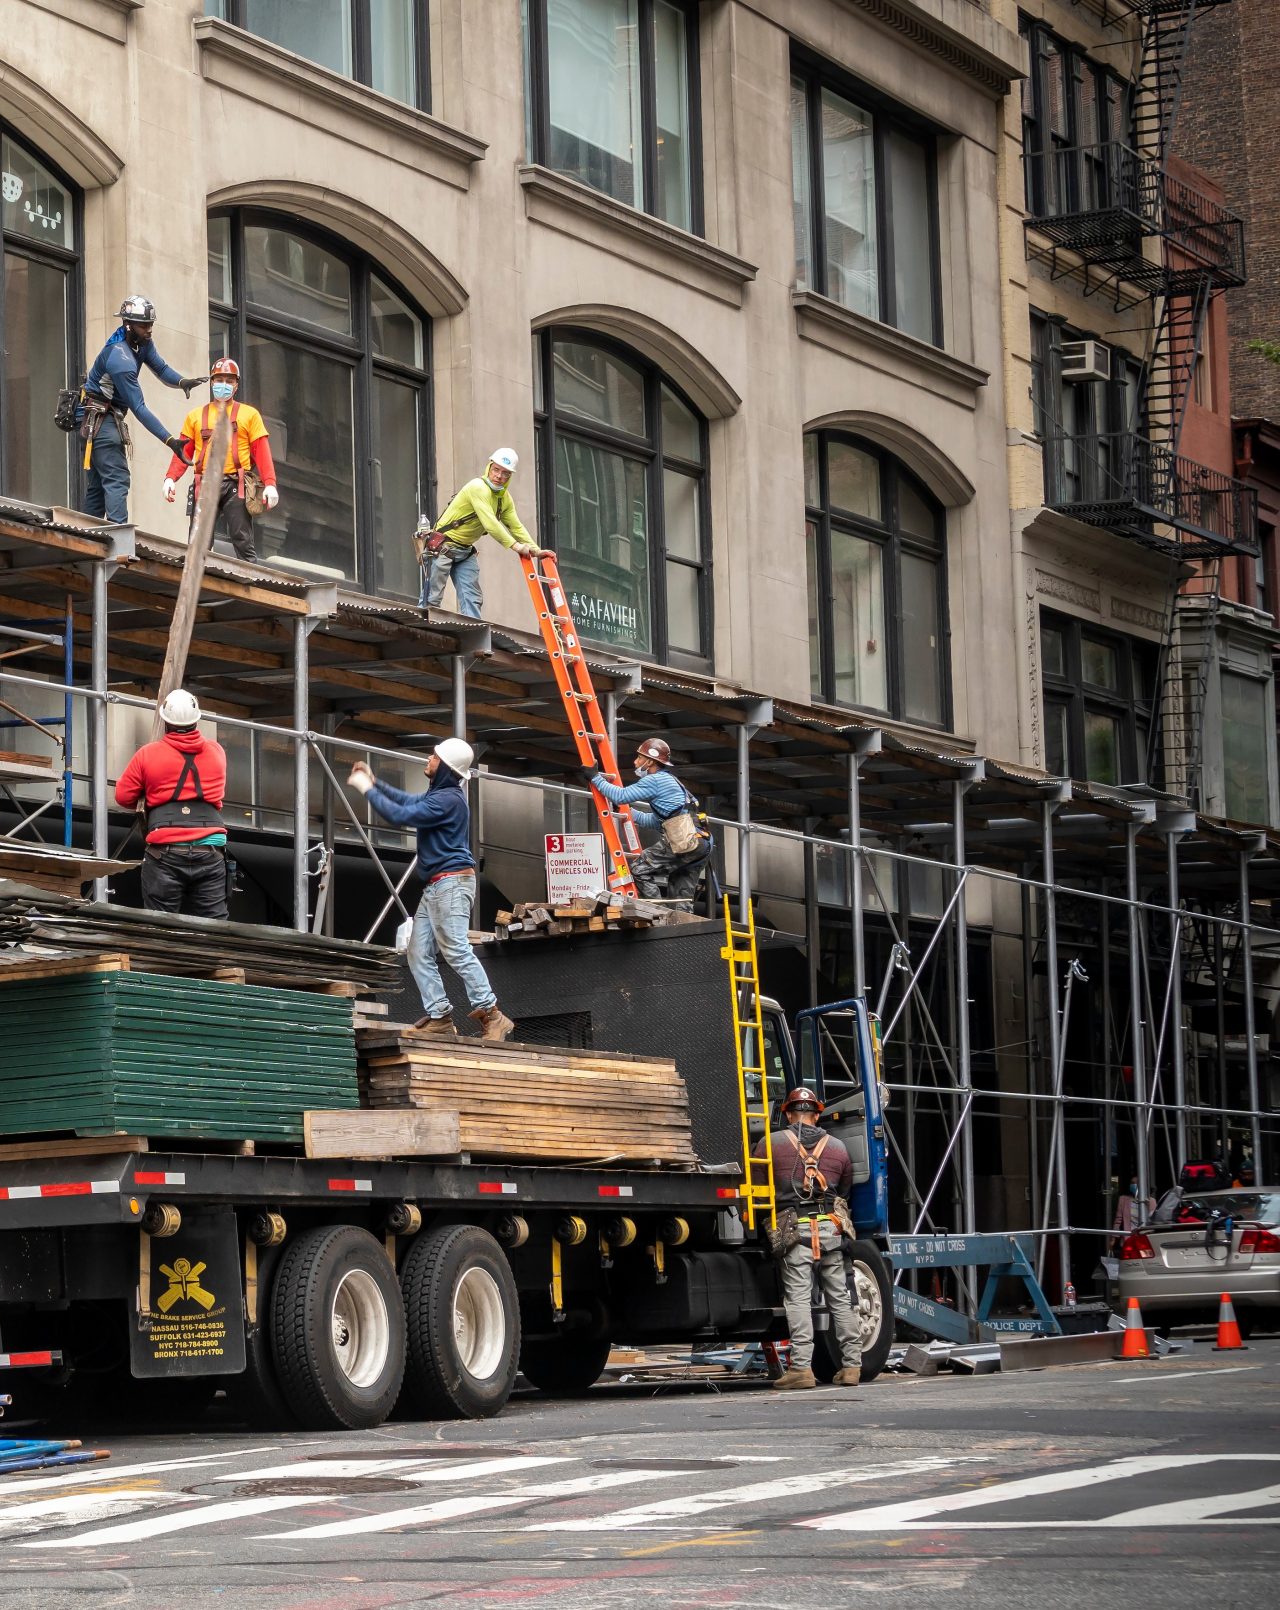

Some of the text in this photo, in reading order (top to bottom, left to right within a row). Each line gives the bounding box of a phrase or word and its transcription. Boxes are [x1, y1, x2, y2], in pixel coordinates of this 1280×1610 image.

[580, 594, 637, 629] SAFAVIEH
[571, 615, 637, 639] HOME FURNISHINGS
[550, 836, 561, 852] 3
[551, 867, 582, 875] VEHICLES
[905, 1242, 918, 1254] LINE
[925, 1241, 934, 1253] DO
[934, 1240, 946, 1252] NOT
[947, 1239, 966, 1252] CROSS
[915, 1255, 935, 1264] NYPD
[898, 1292, 906, 1304] DO
[907, 1296, 918, 1310] NOT
[918, 1301, 935, 1317] CROSS
[181, 1313, 206, 1321] SERVICE
[206, 1307, 226, 1317] GROUP
[151, 1324, 180, 1332] NASSAU
[1018, 1321, 1045, 1331] DEPT.
[149, 1333, 182, 1341] SUFFOLK
[154, 1351, 179, 1359] BRONX
